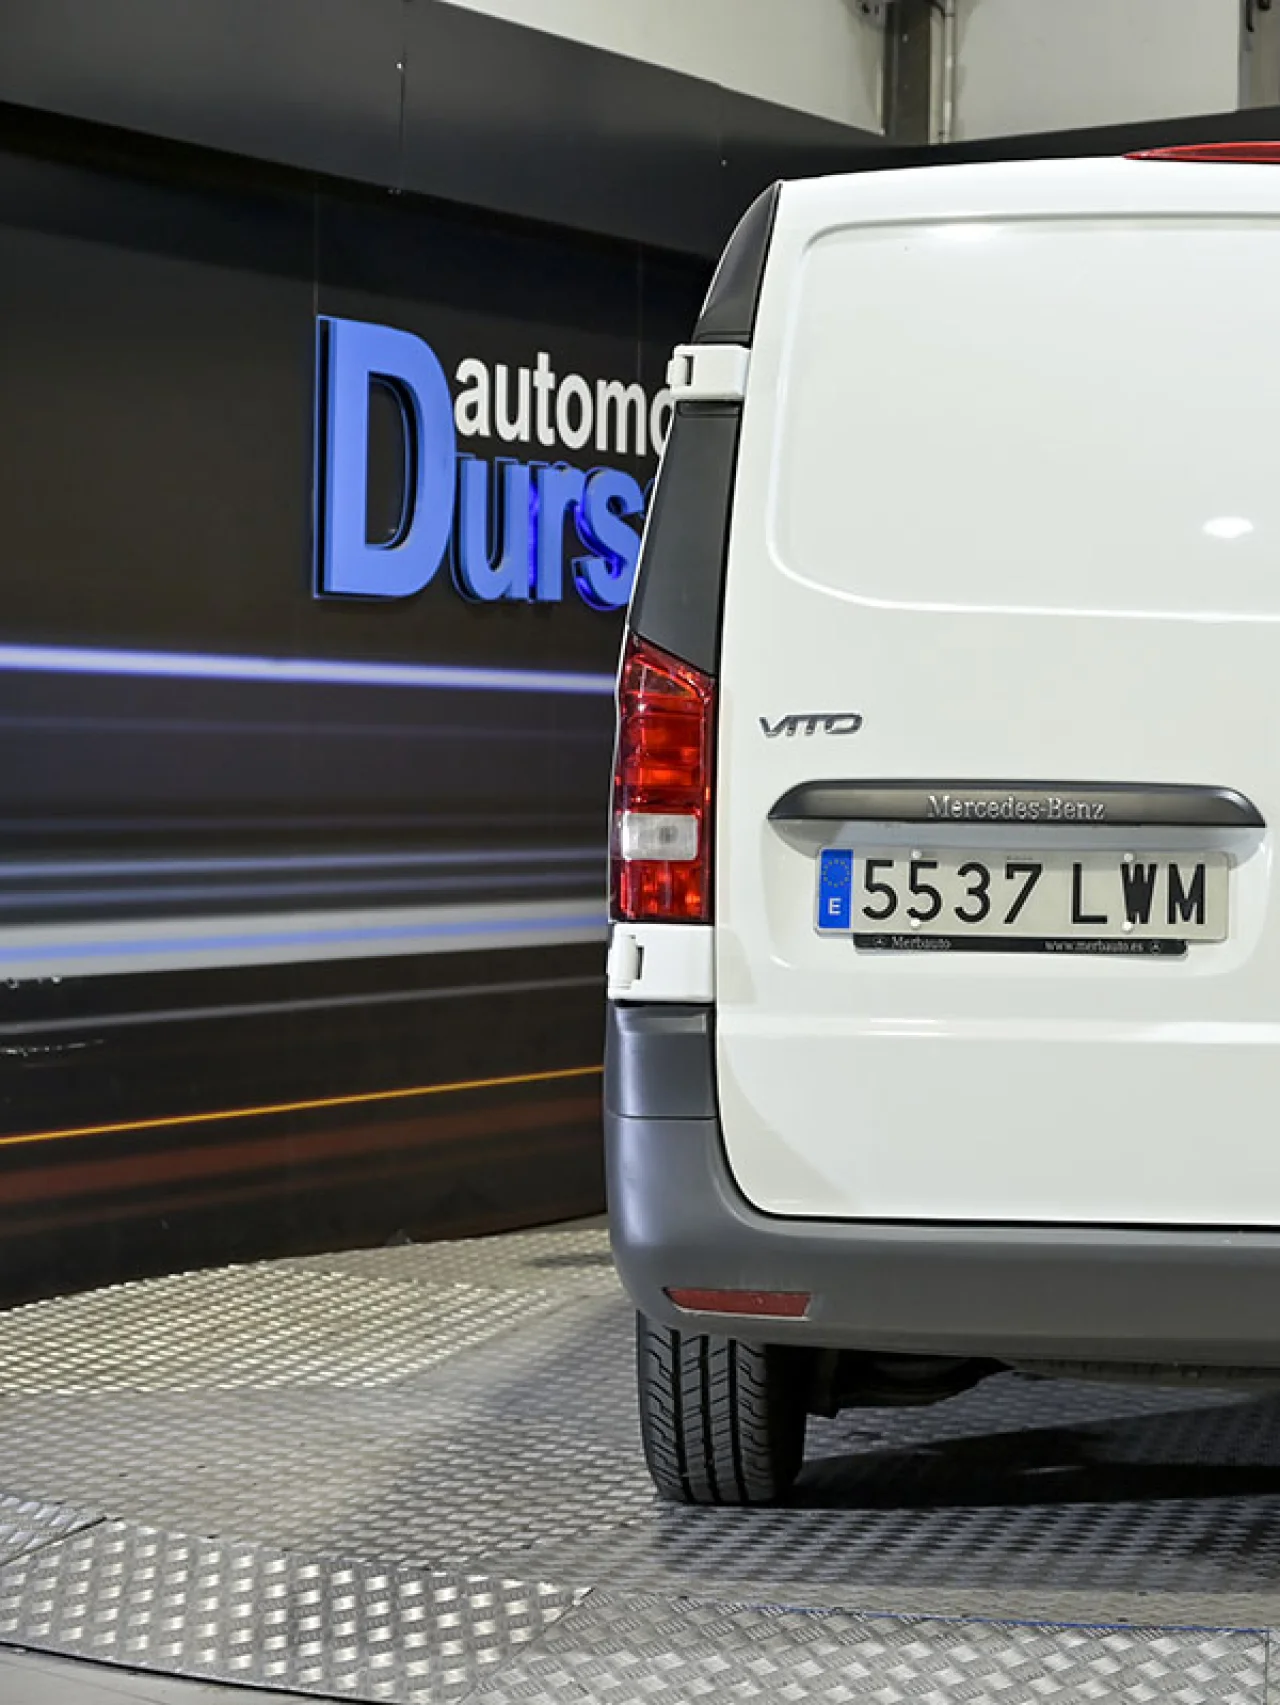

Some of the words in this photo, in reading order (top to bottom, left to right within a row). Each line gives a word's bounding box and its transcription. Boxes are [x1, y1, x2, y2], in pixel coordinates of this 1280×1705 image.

[313, 315, 657, 611] Durs
[758, 712, 863, 738] VITO
[928, 795, 1106, 820] Mercedes-Benz
[862, 859, 1044, 925] 5537
[1070, 862, 1206, 925] LWM
[828, 897, 841, 915] E
